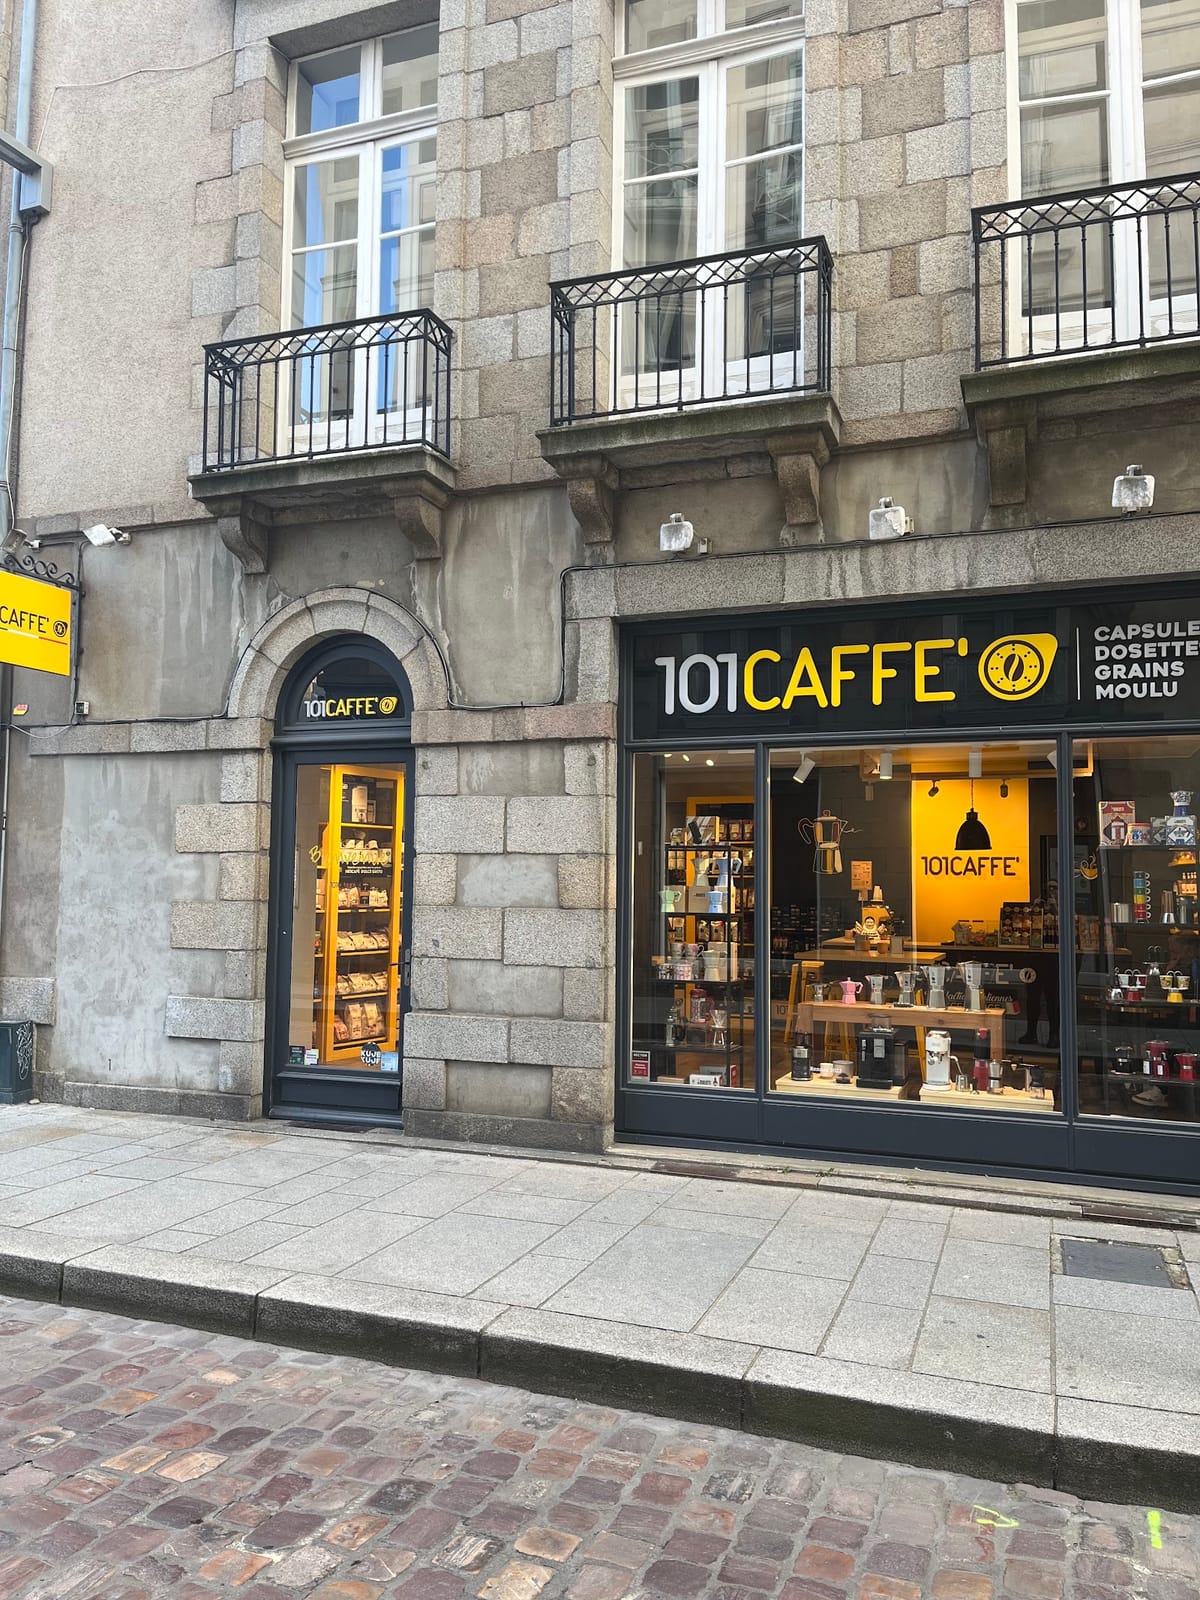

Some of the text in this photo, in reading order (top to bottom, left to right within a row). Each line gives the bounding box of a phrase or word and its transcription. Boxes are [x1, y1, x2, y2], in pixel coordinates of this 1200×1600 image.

[655, 637, 969, 716] 101CAFFE'
[1094, 660, 1185, 681] GRAINS
[1095, 681, 1179, 700] MOULU
[304, 696, 379, 718] 101CAFFE'
[920, 855, 1020, 877] 101CAFFE'
